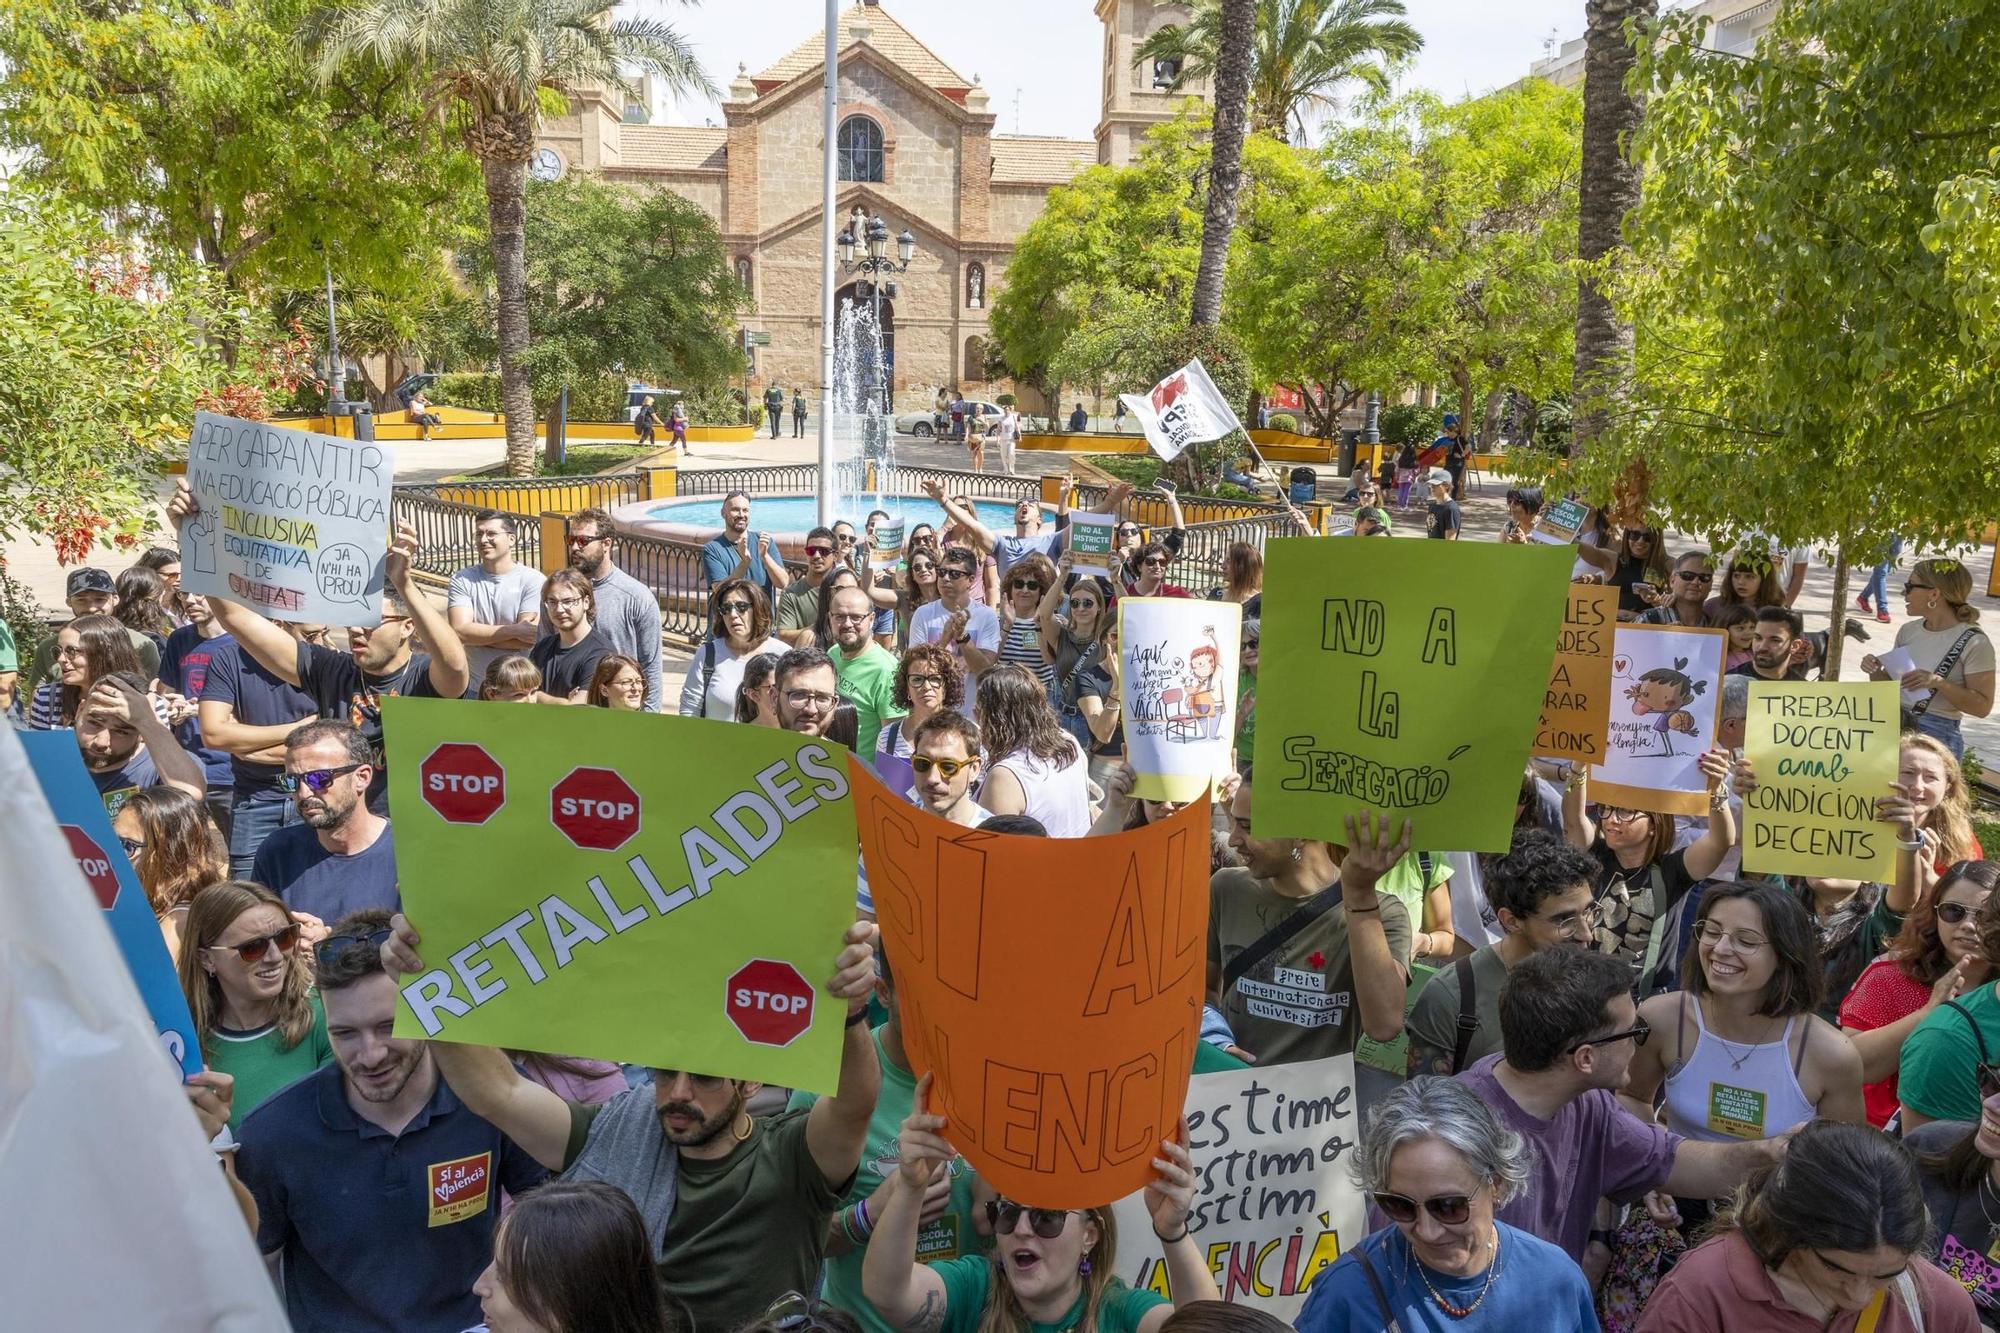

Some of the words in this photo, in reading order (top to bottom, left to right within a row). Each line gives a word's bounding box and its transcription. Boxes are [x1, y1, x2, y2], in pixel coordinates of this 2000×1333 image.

[195, 422, 232, 465] PER
[236, 428, 384, 487] GARANTIR
[192, 468, 216, 496] NA
[218, 473, 303, 509] EDUCACIÓ
[306, 480, 385, 522] PÚBLICA
[222, 504, 319, 549] INCLUSIVA
[1073, 534, 1110, 544] DISTRICTE
[1081, 526, 1092, 534] NO
[1092, 527, 1103, 535] AL
[224, 533, 313, 573] EQUITATIVA
[335, 548, 351, 561] JA
[1082, 543, 1100, 552] ÚNIC
[243, 561, 250, 577] I
[254, 562, 273, 580] DE
[320, 562, 342, 576] N'HI
[346, 563, 363, 577] HA
[323, 576, 362, 595] PROU
[1565, 598, 1605, 626] LES
[1321, 598, 1385, 657] NO
[1421, 607, 1456, 666] A
[1129, 640, 1168, 671] Aquí
[1129, 694, 1163, 720] VAGA
[1358, 671, 1400, 739] LA
[1758, 695, 1886, 724] TREBALL
[1773, 722, 1874, 752] DOCENT
[429, 773, 499, 795] STOP
[1281, 735, 1471, 808] SEGREGACIÓ
[112, 793, 122, 801] JO
[560, 797, 635, 822] STOP
[1755, 823, 1876, 860] DECENTS
[400, 744, 849, 1038] RETALLADES
[873, 794, 999, 1001] SÍ
[1082, 826, 1198, 1017] AL
[734, 988, 808, 1015] STOP
[1239, 978, 1349, 1008] internationale
[1253, 1003, 1339, 1026] universität
[1716, 1091, 1759, 1105] RETALLADES
[1740, 1090, 1753, 1098] LES
[1750, 1104, 1760, 1112] EN
[455, 1166, 465, 1178] al
[917, 1240, 953, 1253] ÚBLICA
